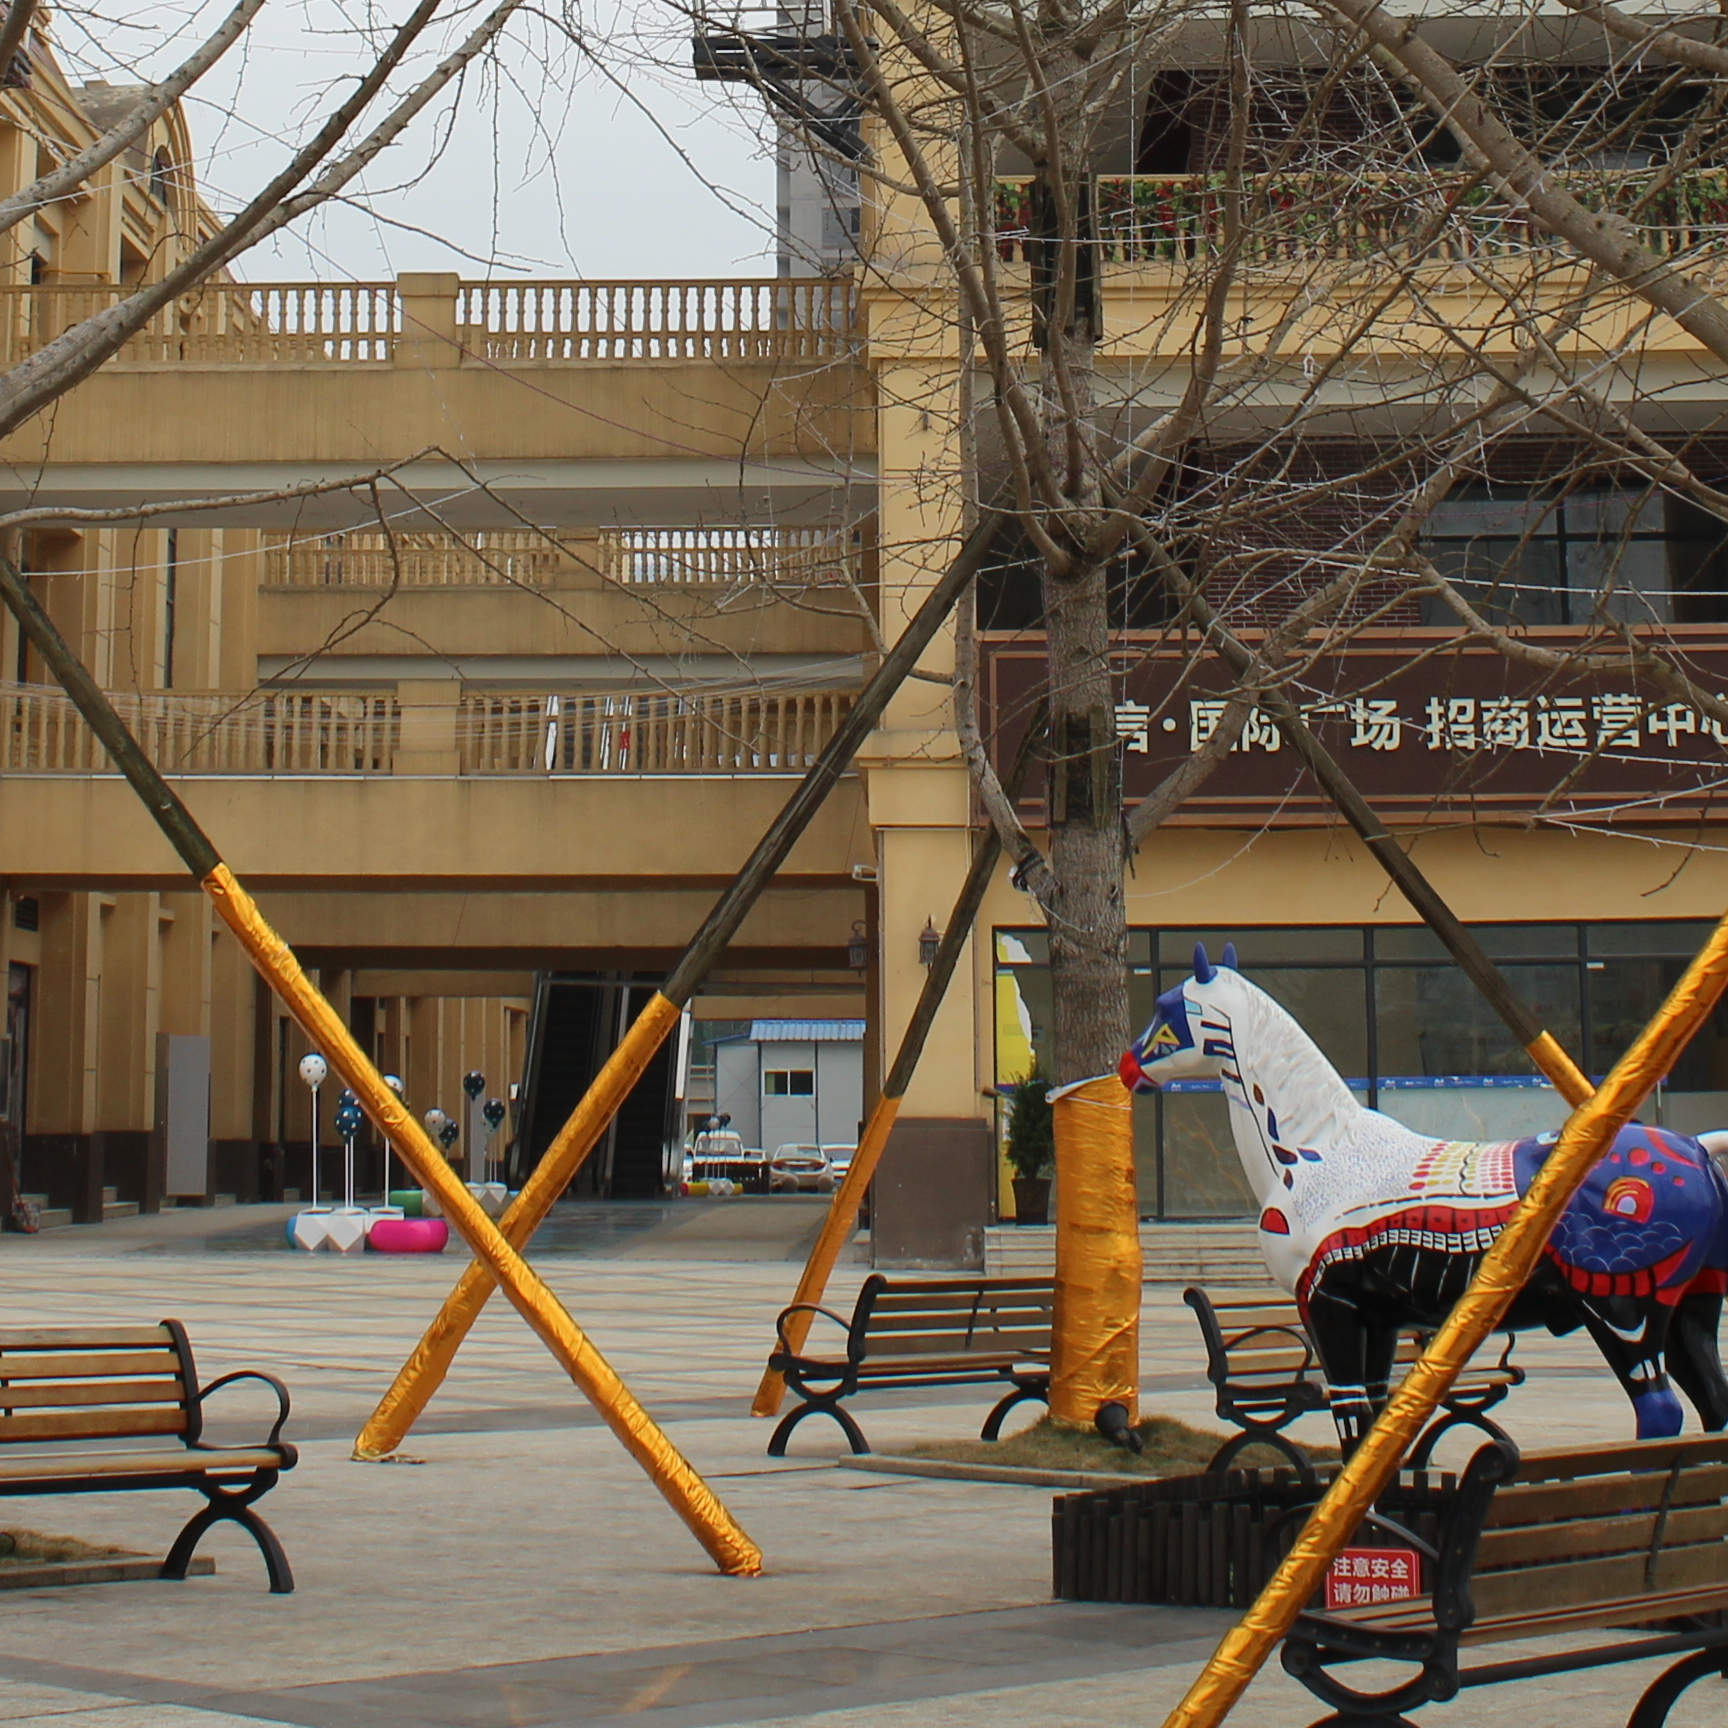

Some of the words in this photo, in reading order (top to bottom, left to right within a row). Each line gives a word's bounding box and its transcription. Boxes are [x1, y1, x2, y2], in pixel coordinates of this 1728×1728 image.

[1333, 1556, 1409, 1579] 注意安全
[1333, 1582, 1410, 1604] 请勿触碰
